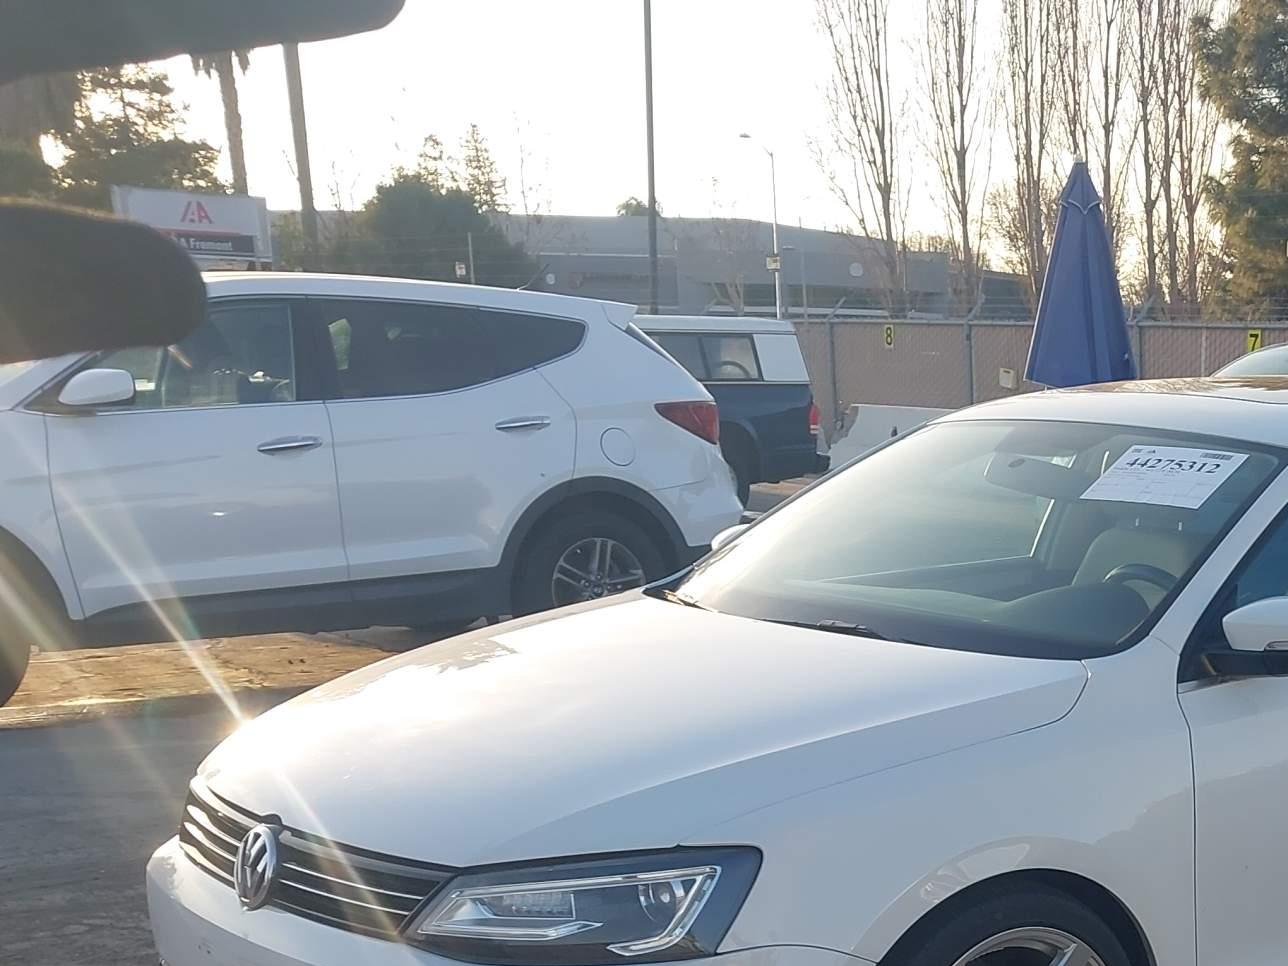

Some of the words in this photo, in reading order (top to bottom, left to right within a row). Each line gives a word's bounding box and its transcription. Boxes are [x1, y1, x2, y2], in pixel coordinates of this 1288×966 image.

[885, 326, 893, 346] 8
[1249, 333, 1259, 352] 7
[1126, 457, 1221, 474] 44275312
